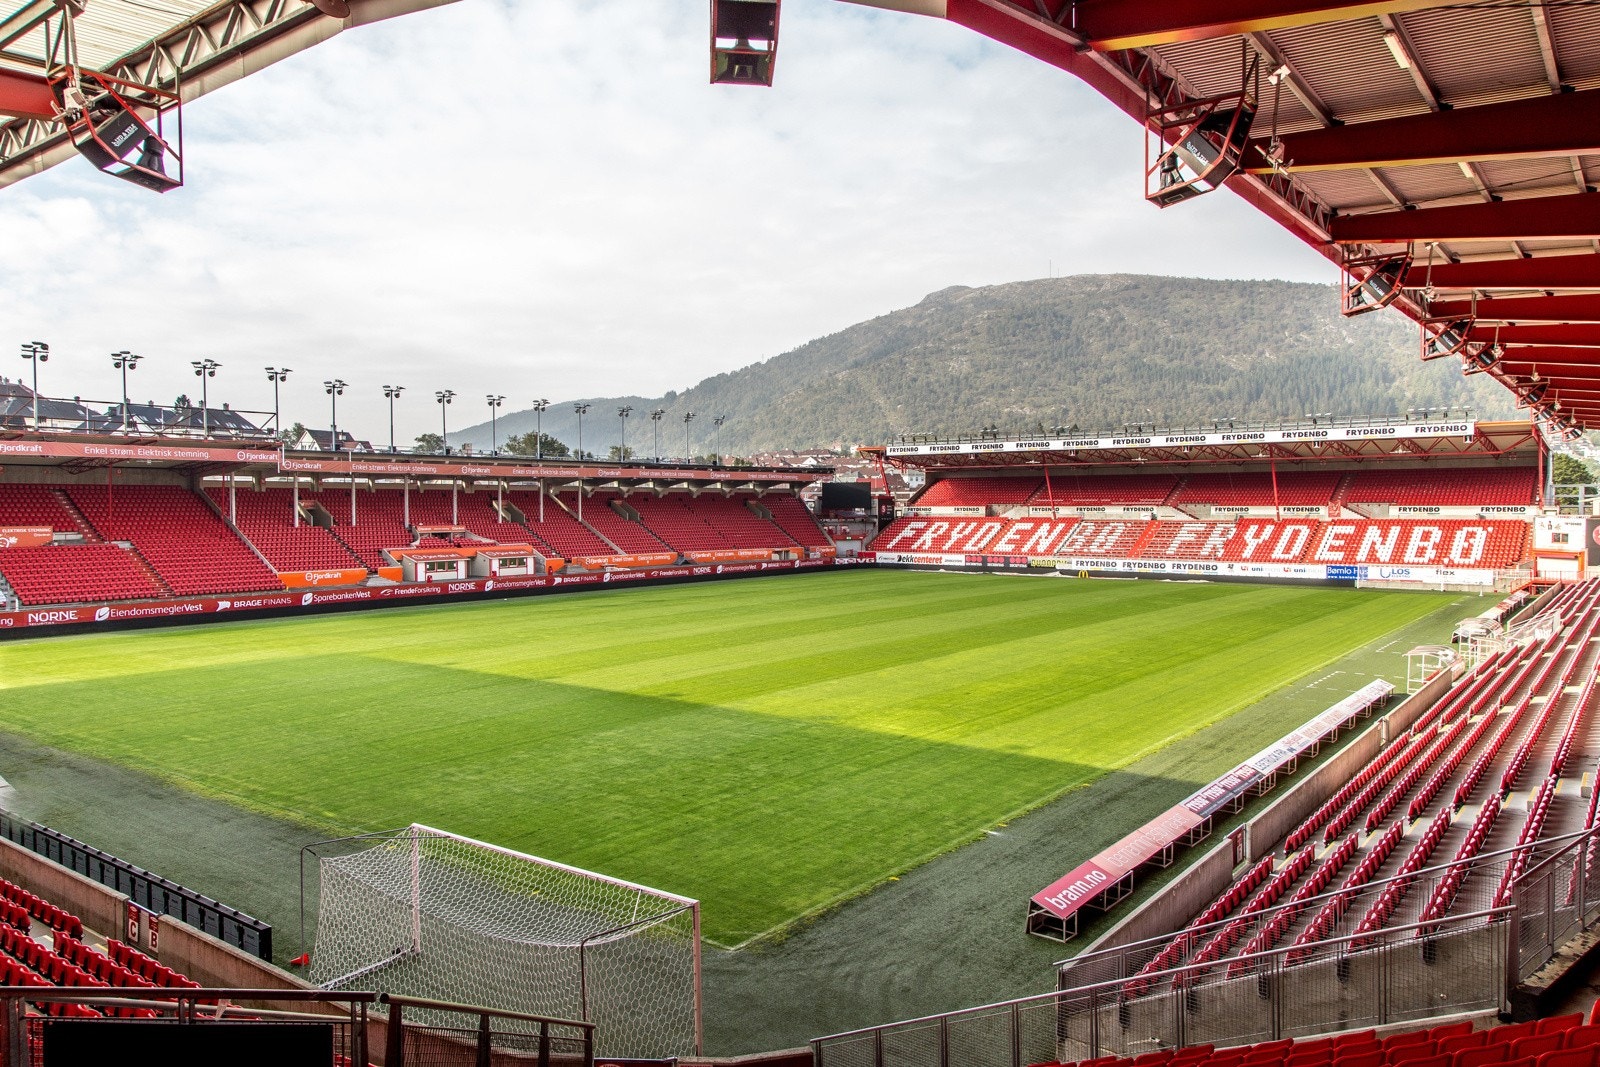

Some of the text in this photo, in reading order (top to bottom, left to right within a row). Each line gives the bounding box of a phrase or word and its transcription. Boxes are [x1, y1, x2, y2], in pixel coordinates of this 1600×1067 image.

[1346, 427, 1396, 436] FRYDENBO
[1415, 424, 1468, 433] FRYDENBO
[1165, 435, 1206, 443] FRYDENBO
[1221, 432, 1265, 441] FRYDENBO
[1281, 430, 1328, 439] FRYDENBO
[1016, 441, 1050, 449] FRYDENBO
[1062, 439, 1099, 447] FRYDENBO
[1112, 437, 1151, 445] FRYDENBO
[0, 443, 42, 453] Fjordkraft
[84, 446, 108, 454] Enkel
[138, 448, 172, 457] Elektrisk
[174, 449, 211, 459] stemning.
[246, 453, 278, 461] Fjordkraft
[292, 462, 322, 470] Fjordkraft
[1075, 560, 1117, 568] FRYDENBO
[1122, 561, 1167, 570] FRYDENBO
[1171, 562, 1218, 571] FRYDENBO
[1327, 566, 1350, 575] Bømlo
[313, 572, 342, 580] Fjordkraft
[394, 586, 441, 595] FrendeForsikring
[448, 582, 476, 590] NORNE
[234, 600, 262, 608] BRAGE
[28, 610, 78, 622] NORNE
[1044, 869, 1107, 911] brann.no
[130, 921, 137, 938] C
[151, 931, 158, 948] B
